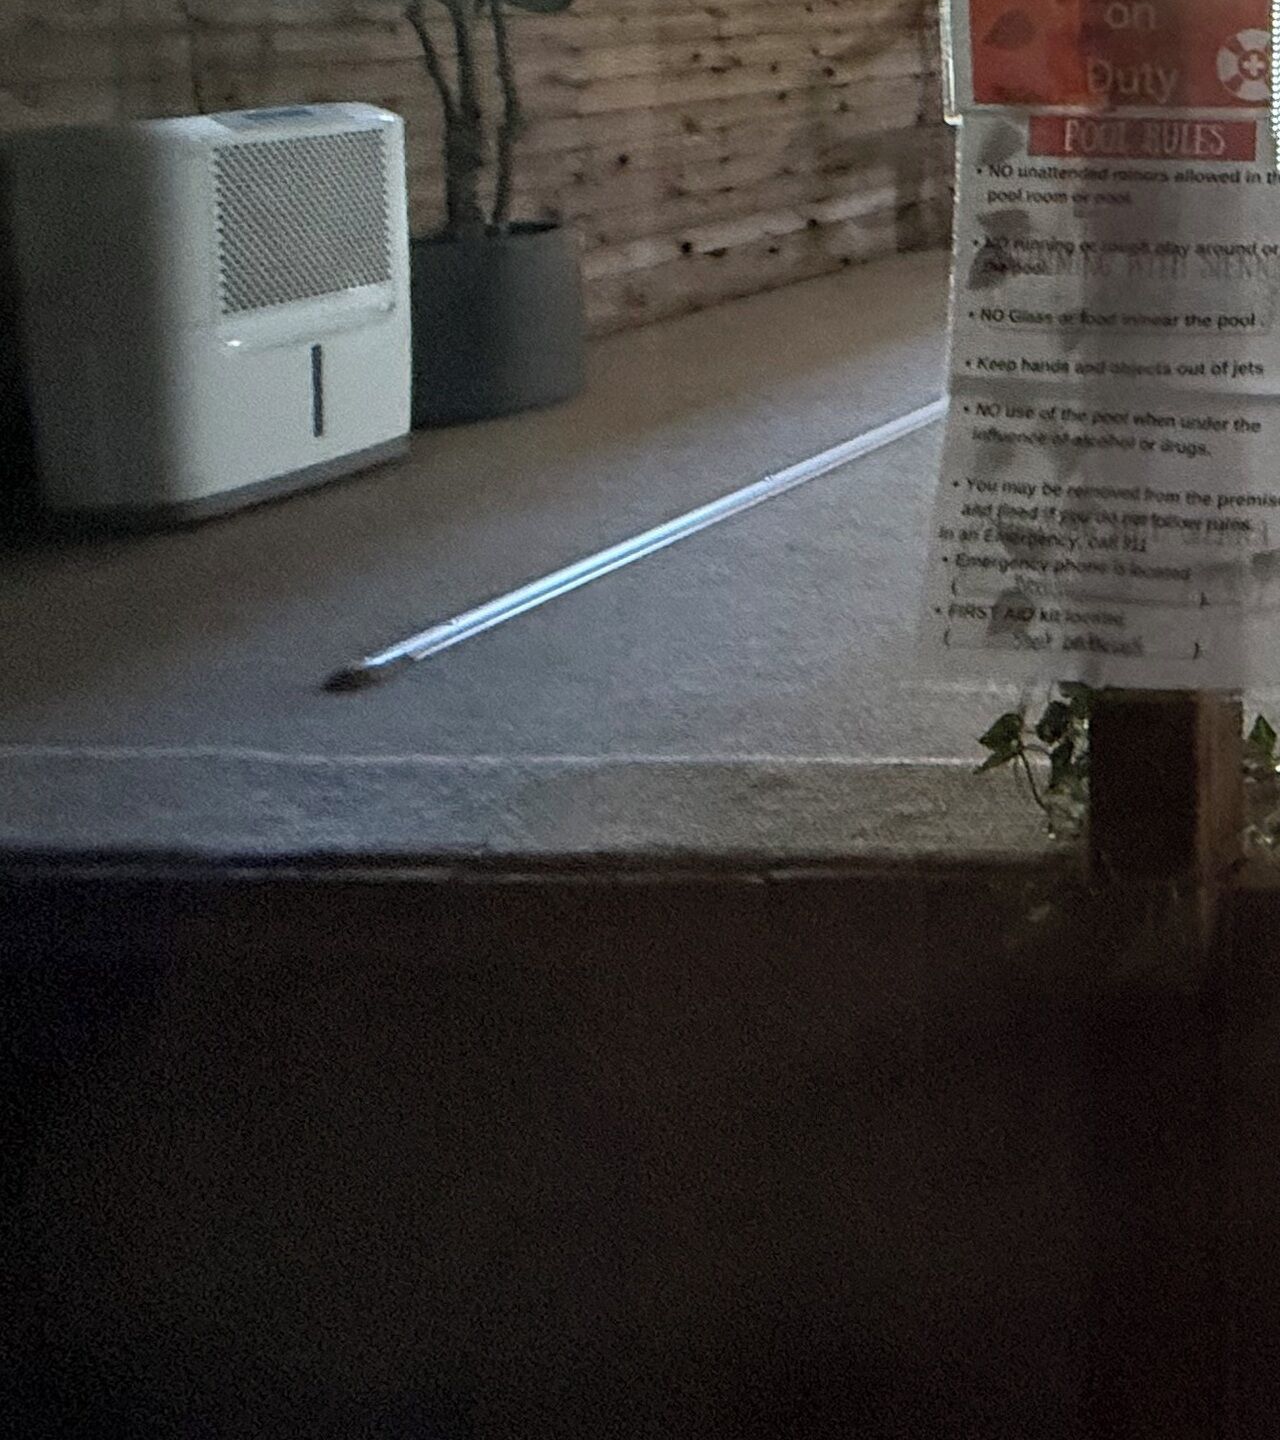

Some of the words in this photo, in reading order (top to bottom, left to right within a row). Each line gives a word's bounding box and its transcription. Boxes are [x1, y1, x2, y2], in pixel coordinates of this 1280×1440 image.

[1105, 1, 1157, 30] on
[1087, 57, 1178, 104] Duty
[989, 164, 1013, 178] NO
[1174, 169, 1240, 185] allowed
[1247, 171, 1261, 184] in
[987, 187, 1023, 204] pool
[980, 309, 1003, 322] NO
[1184, 313, 1212, 327] the
[977, 357, 1016, 373] Keep
[1176, 361, 1205, 376] out
[1211, 360, 1229, 376] of
[1230, 360, 1264, 379] jets
[976, 404, 998, 418] NO
[1005, 406, 1034, 420] use
[1039, 405, 1057, 421] of
[1133, 410, 1176, 428] when
[1180, 413, 1229, 432] under
[1233, 415, 1262, 434] the
[964, 477, 996, 493] You
[1002, 480, 1036, 498] may
[1185, 489, 1212, 507] the
